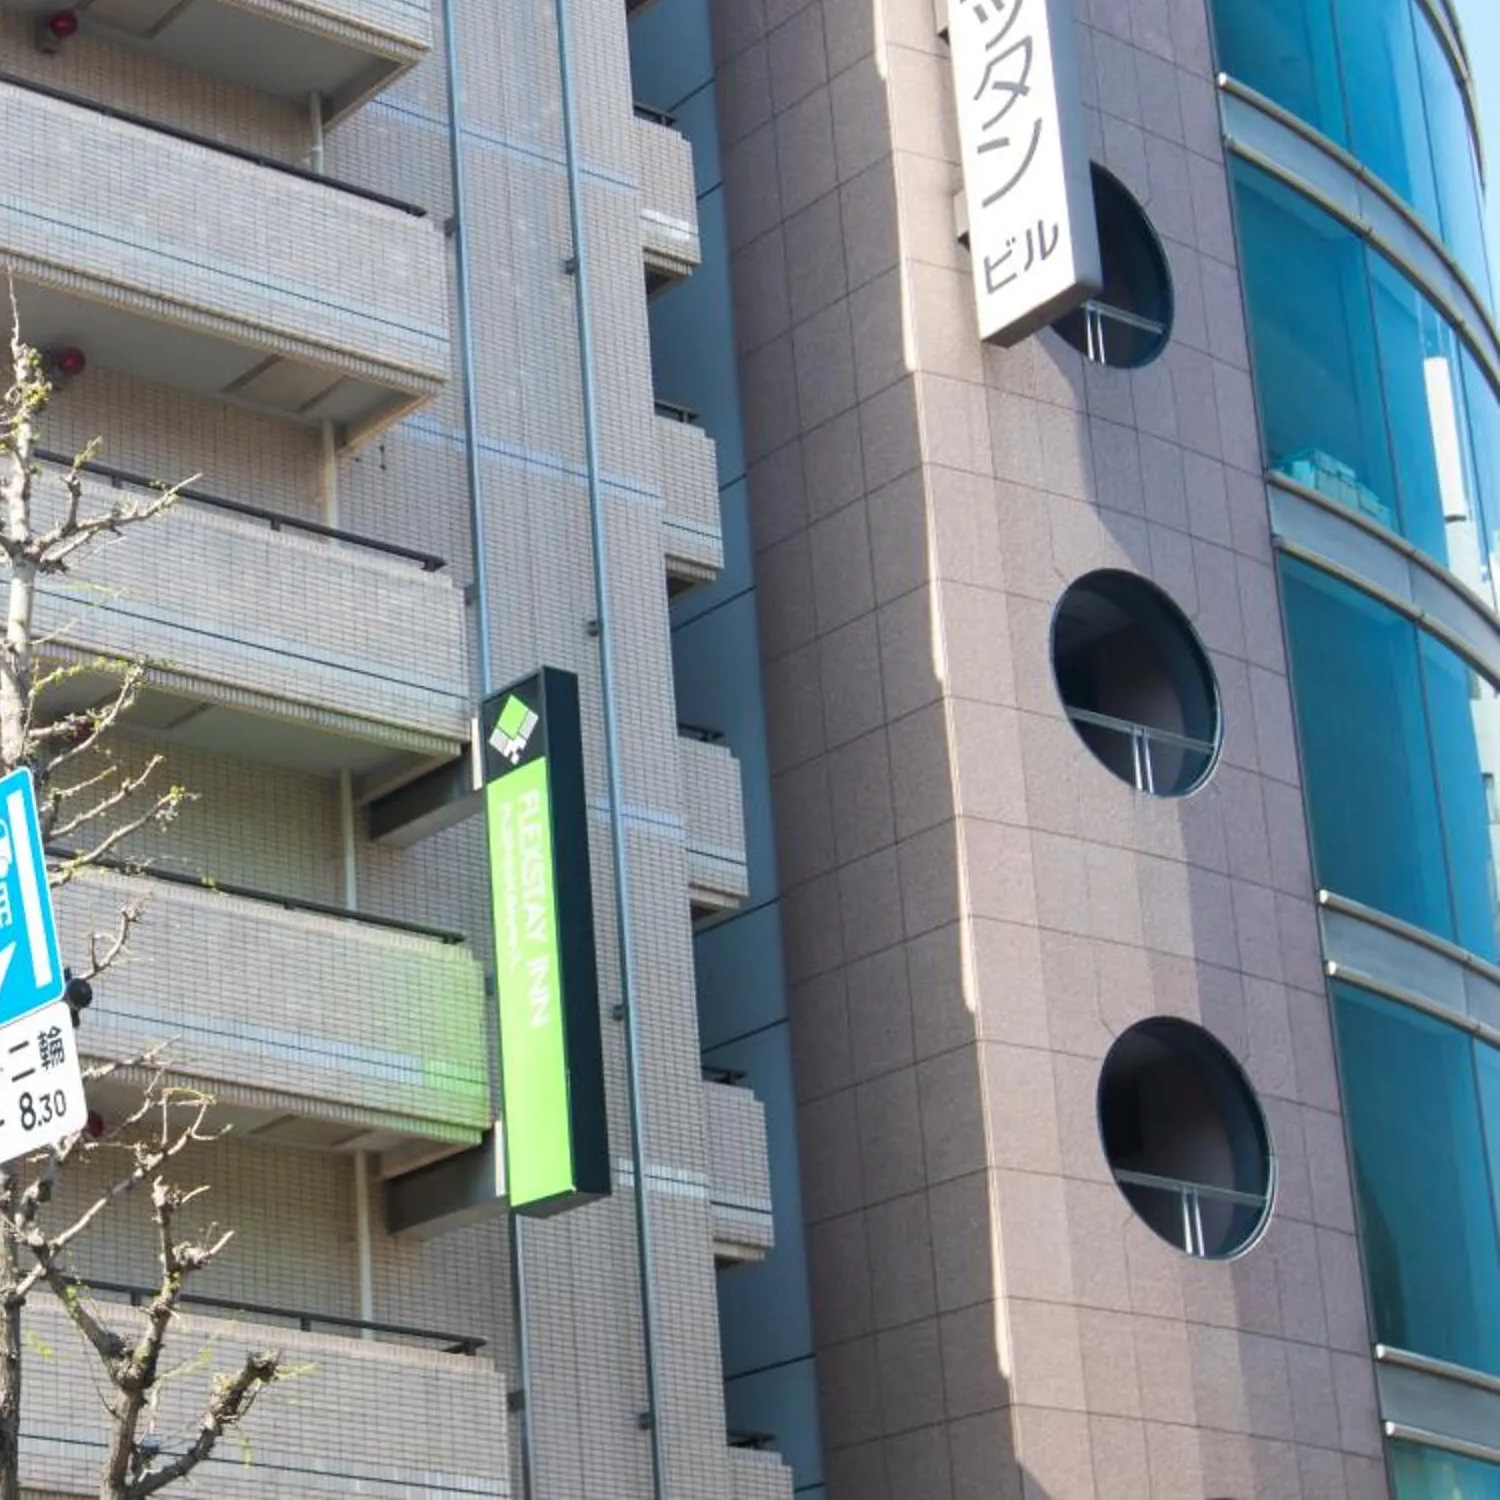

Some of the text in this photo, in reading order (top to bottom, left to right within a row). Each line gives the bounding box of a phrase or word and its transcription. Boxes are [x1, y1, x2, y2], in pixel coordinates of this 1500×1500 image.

[983, 219, 1060, 295] ビル
[517, 790, 549, 1027] FLEXSTAY INN
